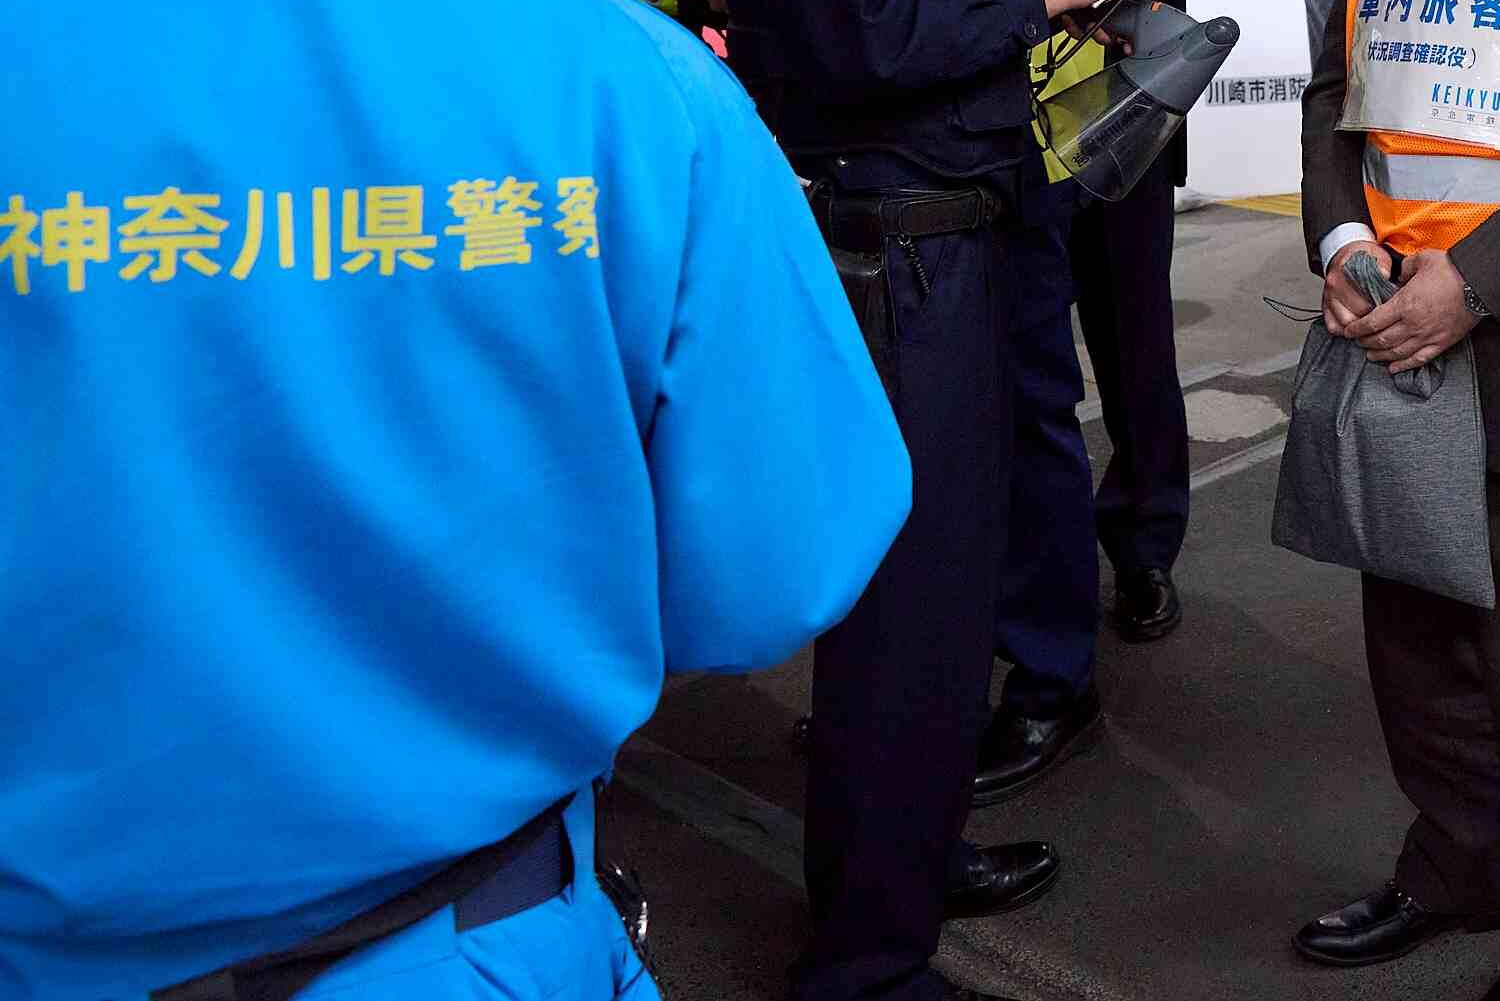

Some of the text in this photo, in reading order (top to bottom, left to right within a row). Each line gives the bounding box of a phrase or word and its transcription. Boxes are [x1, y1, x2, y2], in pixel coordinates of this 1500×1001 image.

[0, 175, 601, 296] 神奈川県警察
